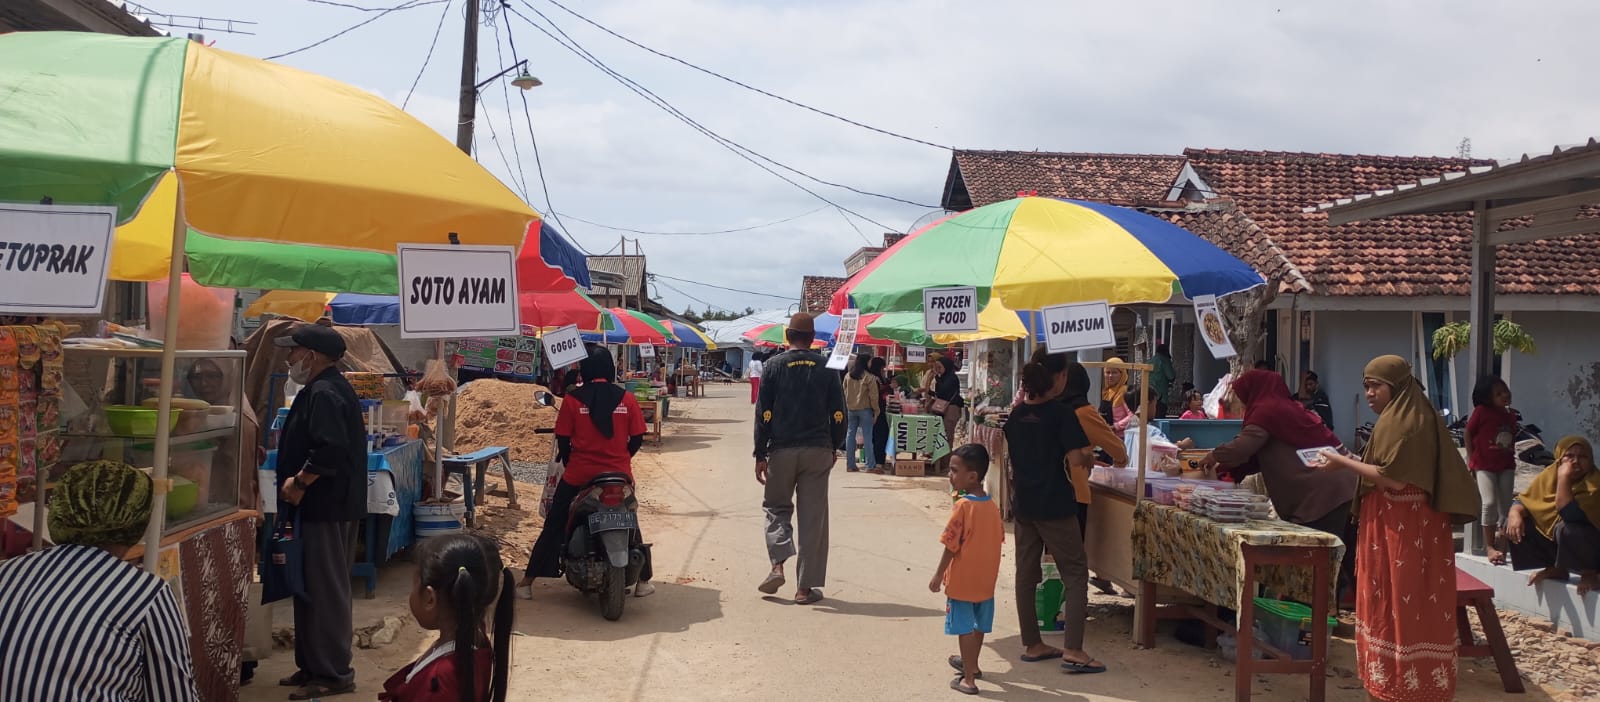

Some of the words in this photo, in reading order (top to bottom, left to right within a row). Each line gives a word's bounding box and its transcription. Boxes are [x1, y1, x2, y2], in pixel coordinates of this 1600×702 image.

[410, 276, 455, 305] SOTO
[458, 277, 506, 305] AYAM
[931, 295, 971, 309] FROZEN
[938, 311, 967, 324] FOOD
[1051, 317, 1105, 335] DIMSUM
[550, 337, 577, 355] GOGOS
[897, 422, 908, 451] UNIT
